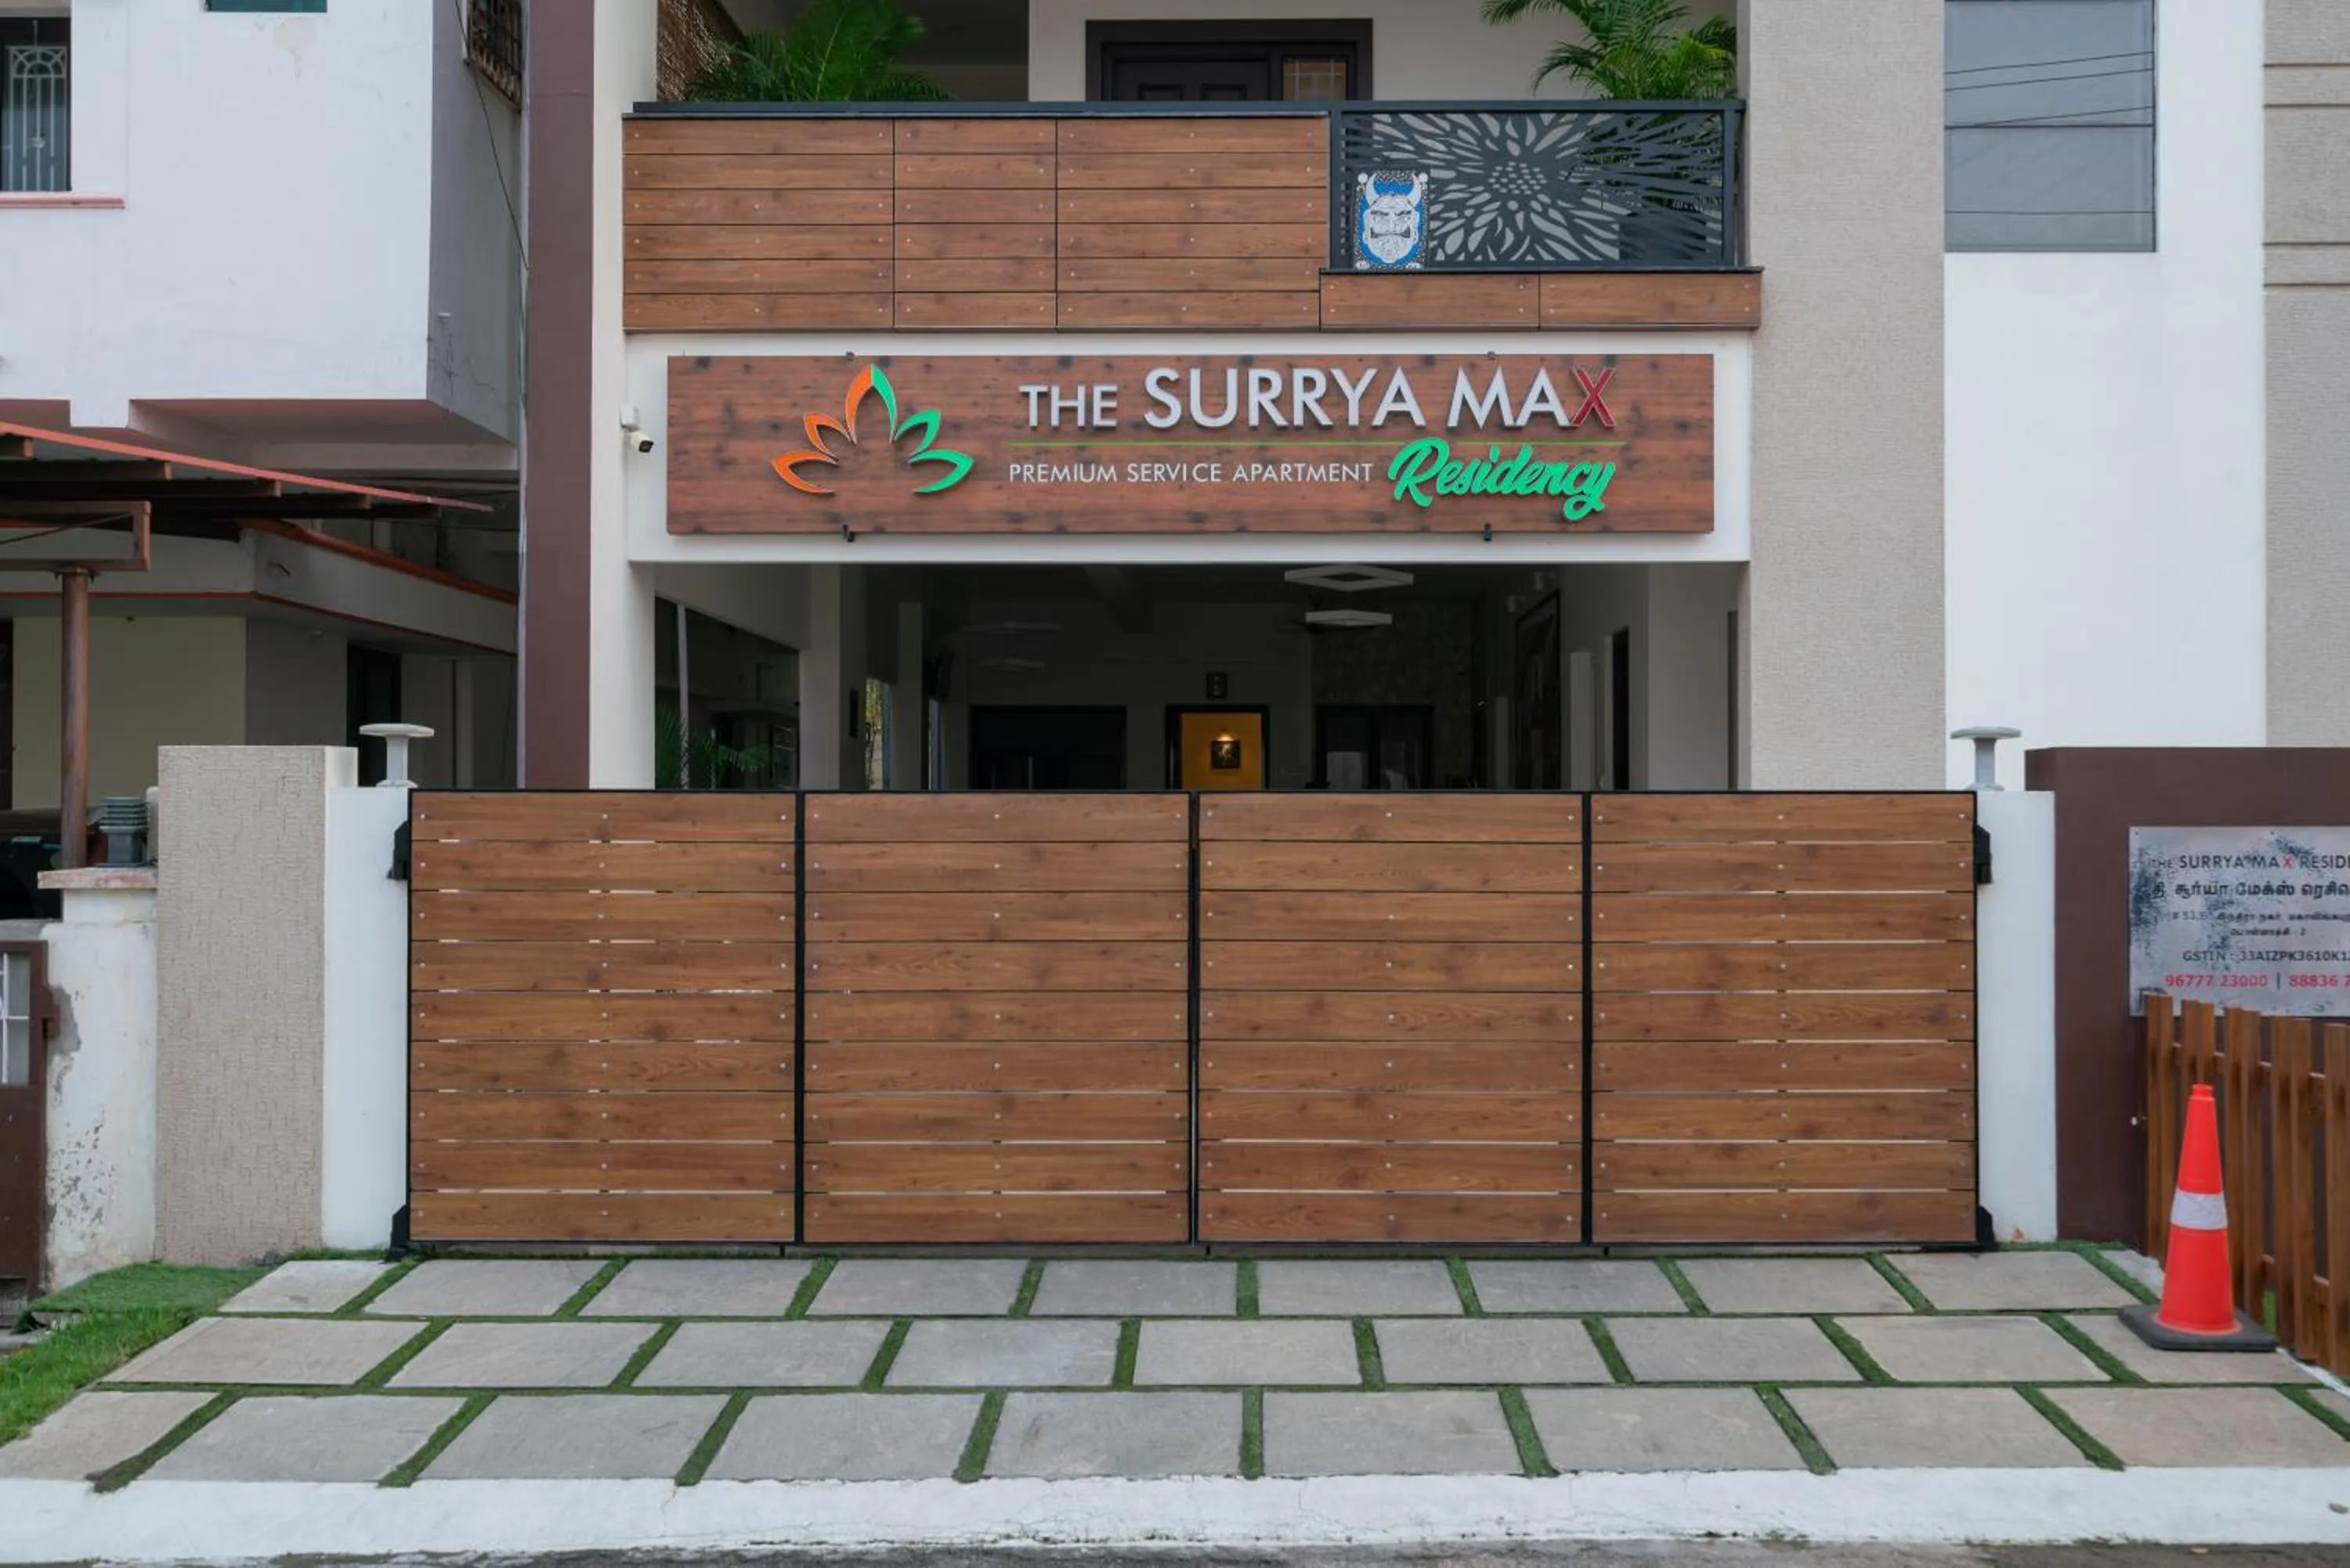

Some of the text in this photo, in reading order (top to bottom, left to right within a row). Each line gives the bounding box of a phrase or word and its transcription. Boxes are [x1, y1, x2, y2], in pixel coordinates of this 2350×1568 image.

[1018, 365, 1617, 429] THE SURRYA MAX
[1009, 462, 1374, 483] PREMIUM SERVICE APARTMENT
[1386, 436, 1617, 522] Residency
[2179, 854, 2245, 869] SURRYA
[2251, 854, 2294, 869] MAX
[2182, 950, 2226, 962] GSTIN
[2239, 950, 2350, 962] 33AIZPK3610K1
[2164, 974, 2214, 988] 96777
[2219, 974, 2268, 988] 23000
[2288, 974, 2339, 988] 88836
